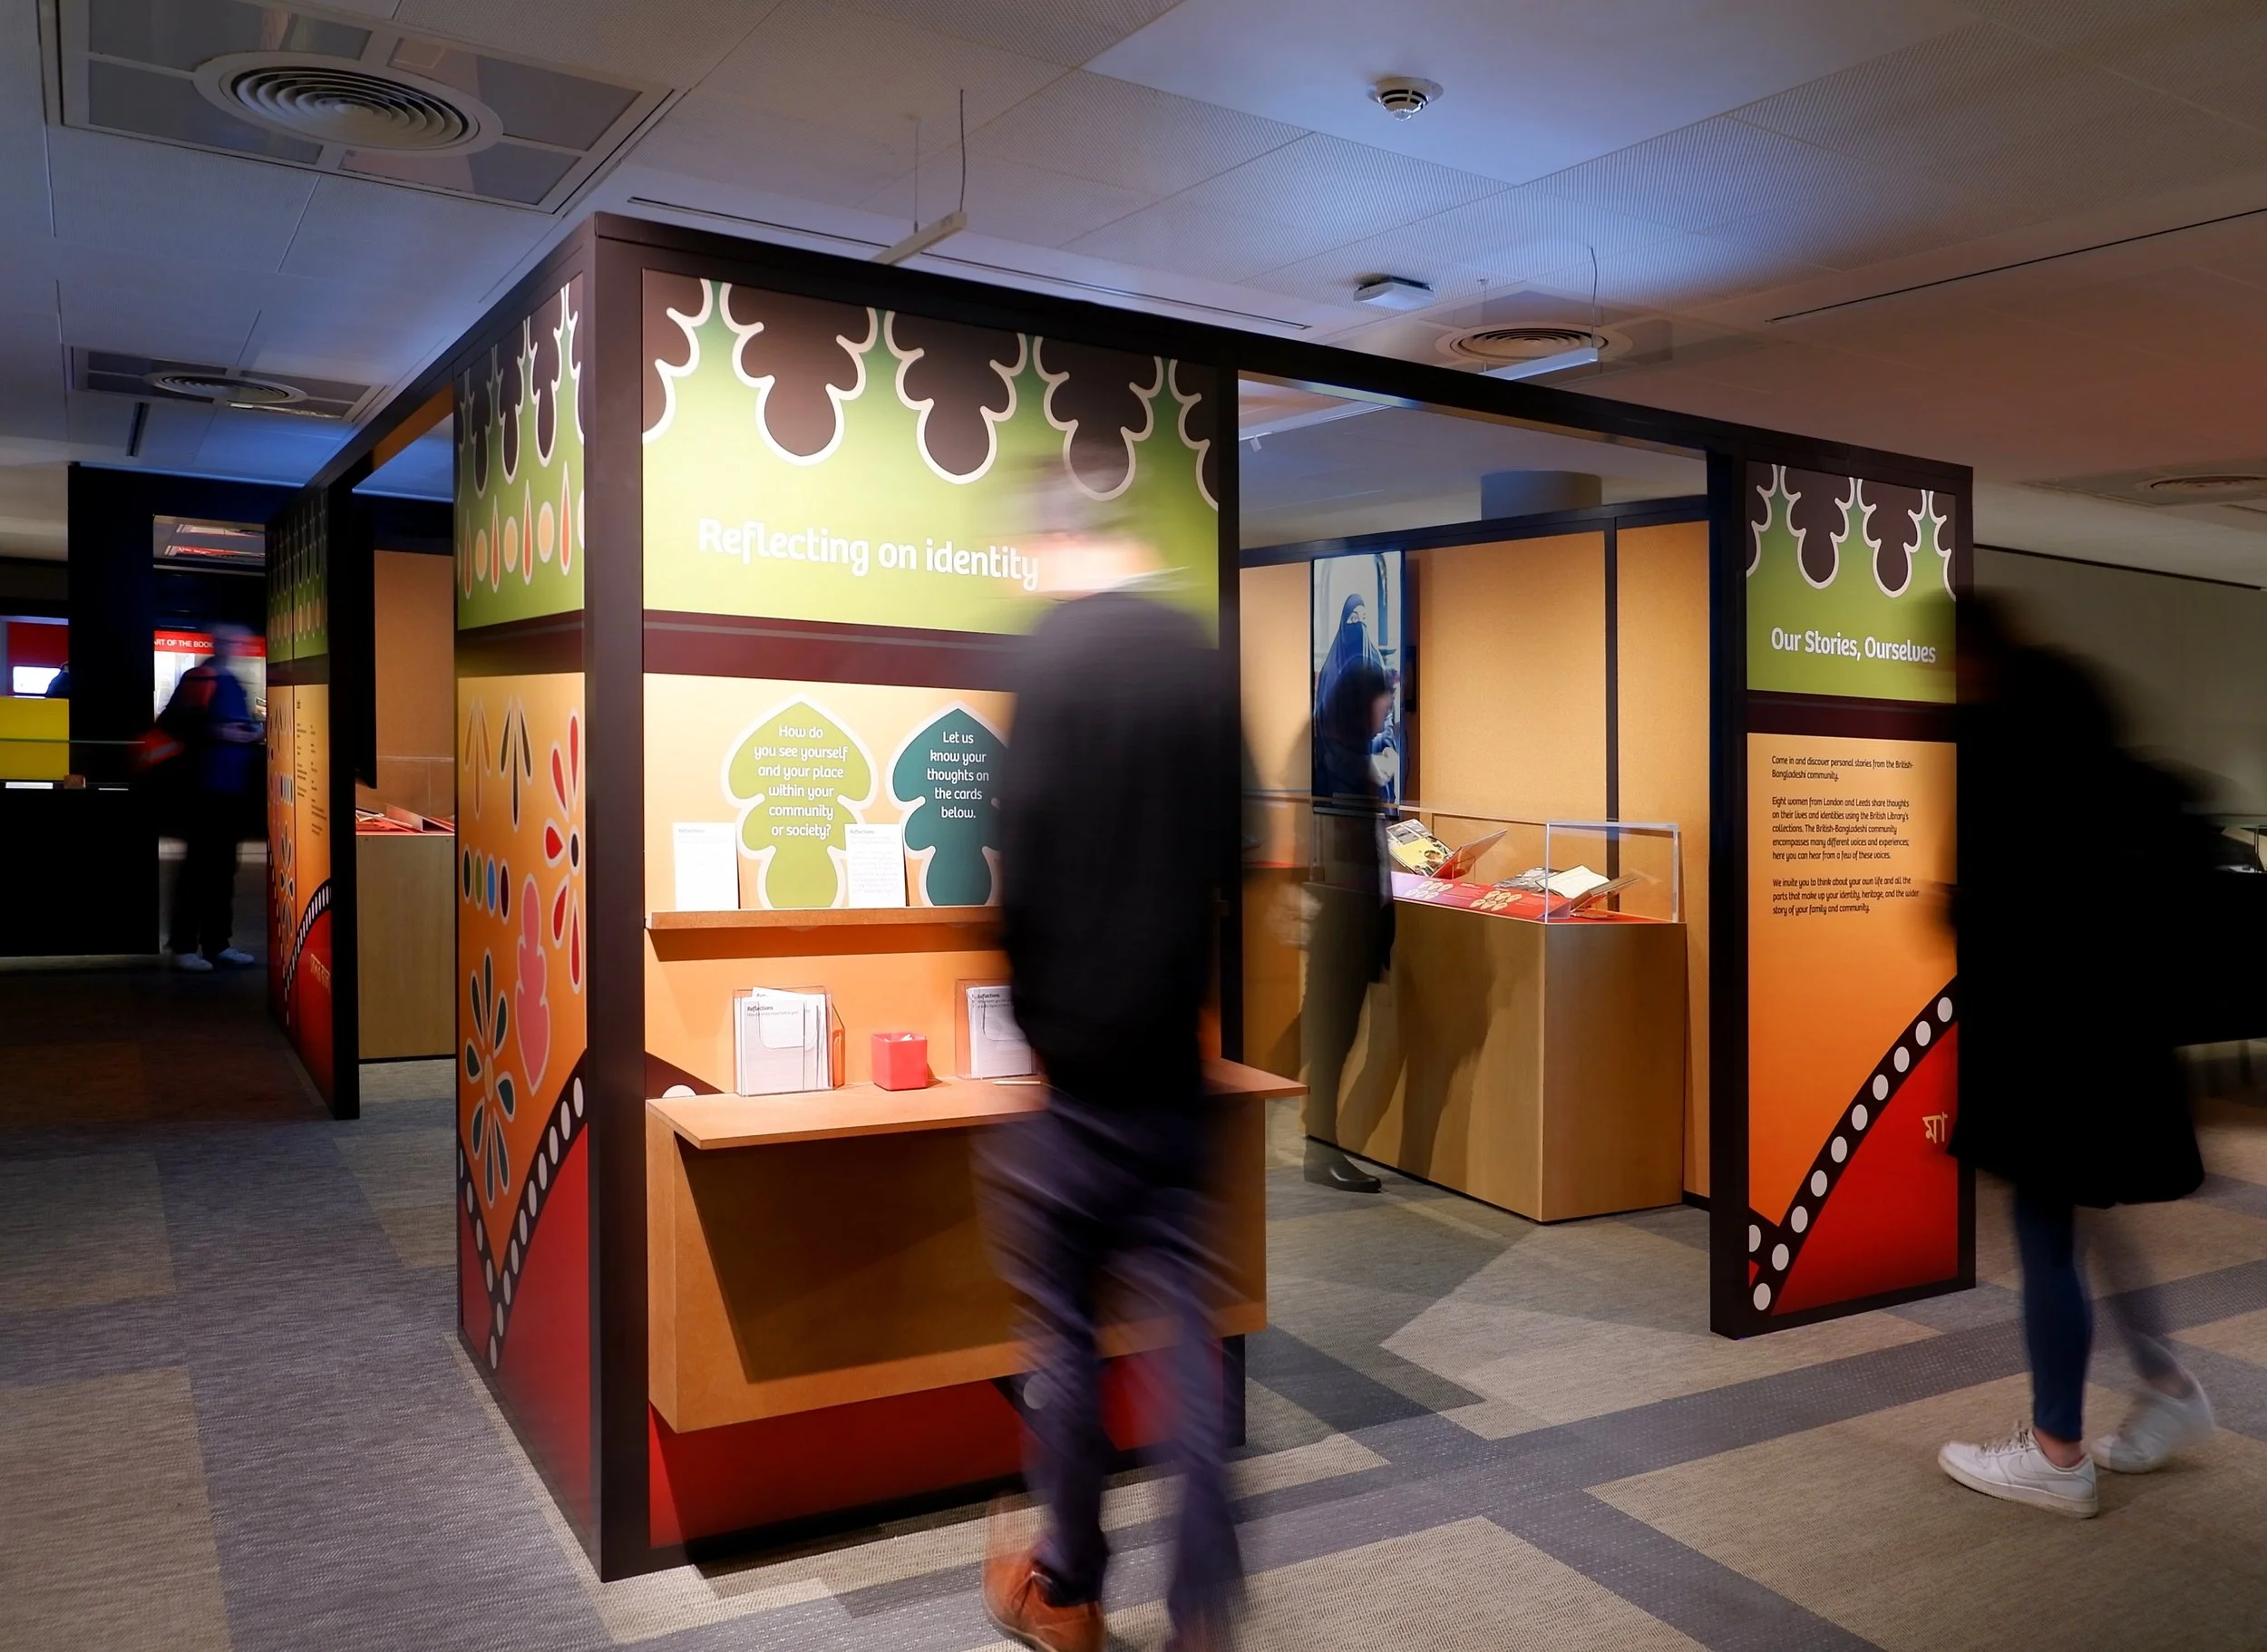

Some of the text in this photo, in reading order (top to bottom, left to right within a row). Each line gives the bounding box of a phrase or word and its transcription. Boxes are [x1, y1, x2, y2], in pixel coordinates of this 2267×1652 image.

[698, 518, 1038, 591] Reflecting on identity
[1771, 627, 1936, 663] Our Stories, Ourselves
[779, 725, 823, 738] How do
[943, 732, 974, 743] Let us
[754, 746, 848, 762] you see yourself
[930, 750, 986, 765] know your
[1772, 756, 1787, 764] Come
[1789, 756, 1794, 764] in
[1795, 757, 1805, 765] and
[1807, 757, 1829, 766] discover
[1831, 758, 1853, 767] personal
[1854, 759, 1872, 768] stories
[1873, 759, 1885, 769] from
[1886, 760, 1894, 768] the
[758, 765, 843, 780] and your place
[927, 769, 989, 783] thoughts on
[1772, 770, 1805, 780] Bangladeshi
[769, 784, 834, 800] within your
[935, 788, 982, 800] the cards
[1773, 797, 1786, 807] Eight
[1809, 797, 1822, 807] from
[1824, 798, 1844, 806] London
[1845, 798, 1854, 806] and
[1856, 798, 1870, 806] Leeds
[1872, 799, 1885, 807] share
[1887, 799, 1909, 809] thoughts
[769, 804, 833, 820] community
[941, 806, 976, 819] below.
[1781, 811, 1794, 819] their
[1795, 811, 1807, 819] lives
[1809, 811, 1819, 819] and
[1845, 811, 1859, 821] using
[1870, 811, 1886, 820] British
[772, 824, 831, 840] or society?
[1773, 824, 1803, 832] collections.
[1805, 824, 1815, 832] The
[1868, 825, 1897, 835] community
[1773, 839, 1809, 847] encompasses
[1810, 840, 1826, 848] many
[1827, 838, 1849, 847] different
[1851, 838, 1866, 846] voices
[1868, 838, 1877, 846] and
[1773, 851, 1785, 860] here
[1786, 852, 1796, 861] you
[1823, 851, 1835, 860] from
[1841, 850, 1851, 860] few
[1853, 850, 1859, 860] of
[1859, 850, 1872, 859] these
[1773, 879, 1781, 887] We
[1799, 879, 1809, 889] you
[1817, 878, 1831, 886] think
[1833, 878, 1847, 886] about
[1849, 879, 1861, 888] your
[1773, 892, 1787, 902] parts
[1802, 891, 1816, 899] make
[1818, 892, 1824, 901] up
[1826, 892, 1838, 901] your
[1885, 889, 1894, 898] and
[1905, 889, 1919, 897] wider
[1773, 906, 1787, 916] story
[1788, 906, 1795, 916] of
[1795, 906, 1808, 916] your
[1809, 904, 1826, 914] family
[1828, 904, 1838, 912] and
